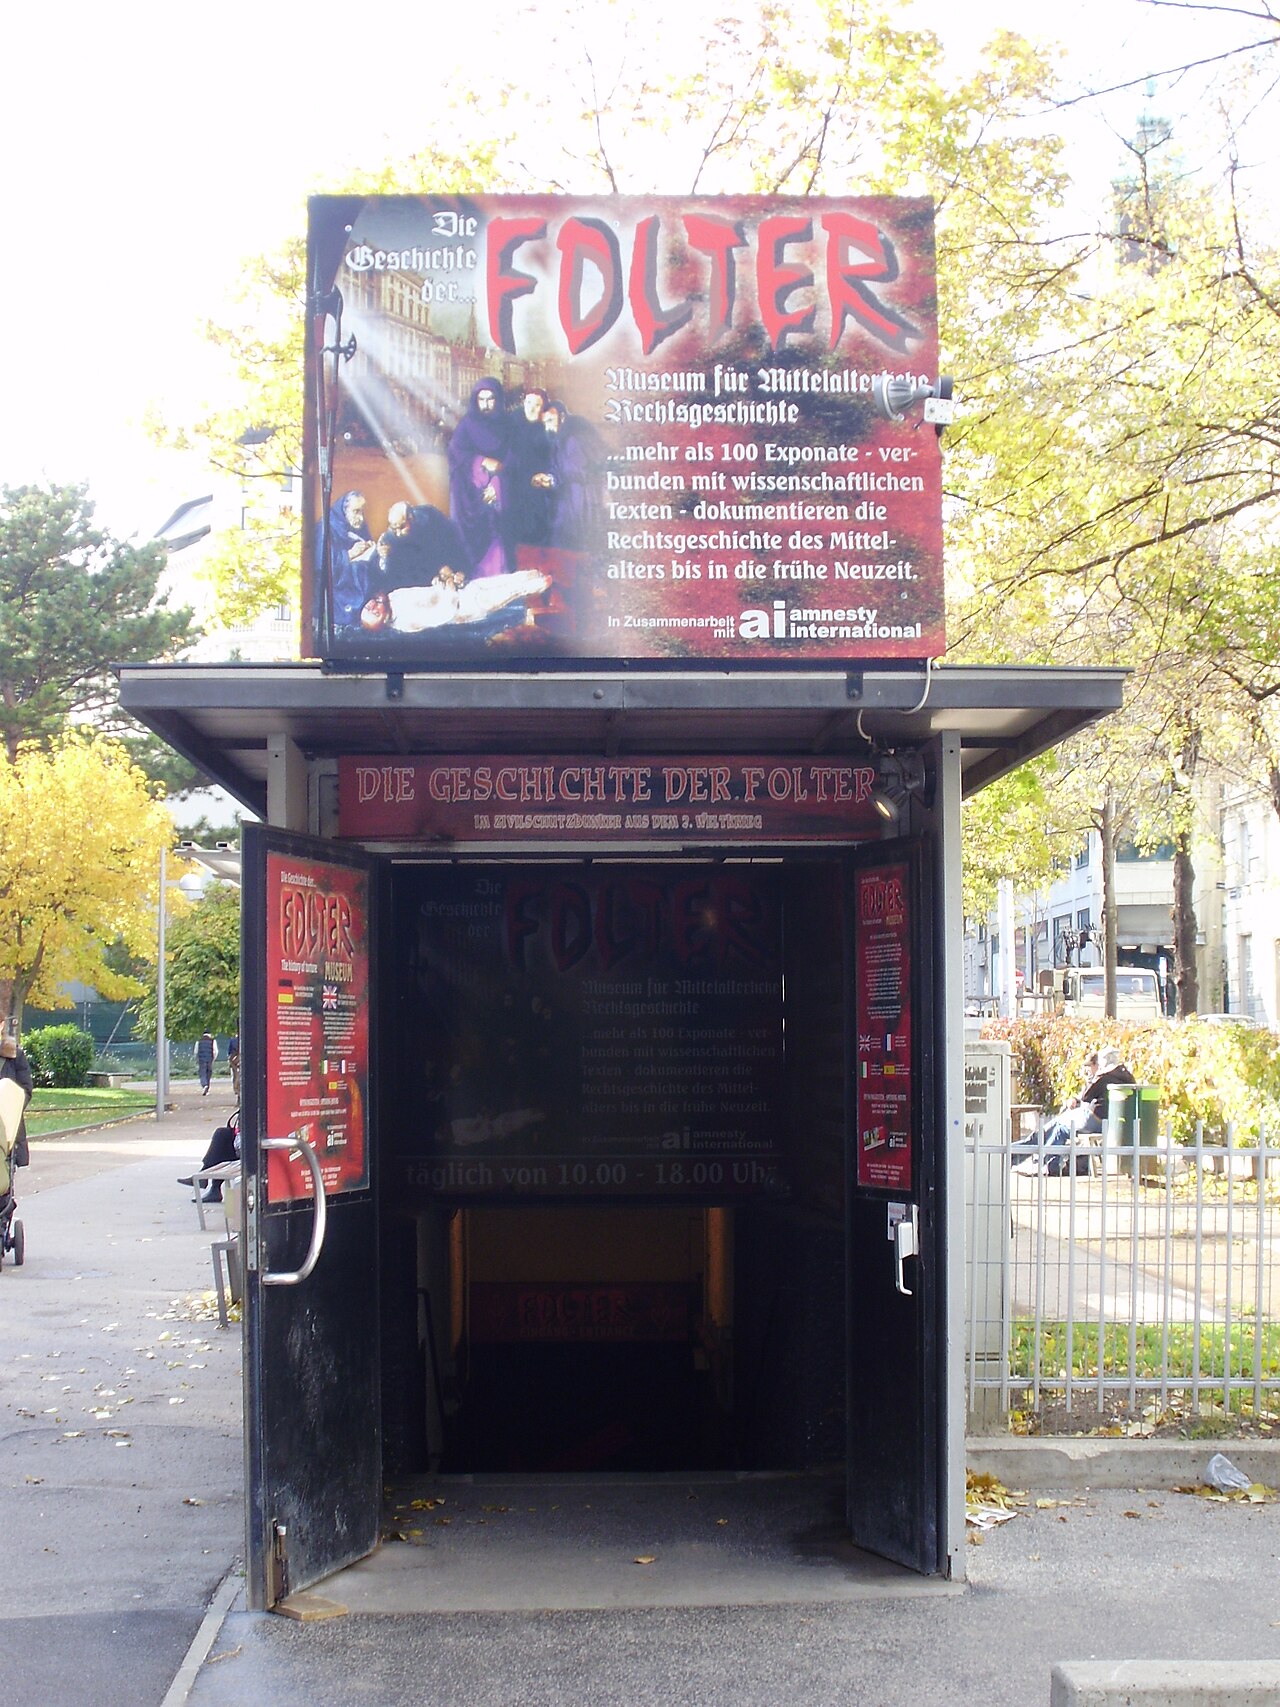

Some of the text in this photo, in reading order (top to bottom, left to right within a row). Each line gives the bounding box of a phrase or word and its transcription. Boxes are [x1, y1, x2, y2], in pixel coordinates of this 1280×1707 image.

[432, 211, 478, 237] Die
[345, 246, 477, 273] Geschichte
[486, 211, 926, 356] FOLTER
[604, 367, 706, 393] Museum
[714, 364, 749, 397] für
[604, 398, 799, 428] Rechtsgeschichte
[685, 442, 714, 462] als
[722, 443, 758, 462] 100
[765, 444, 859, 465] Exponate
[879, 446, 918, 462] ver-
[607, 472, 924, 491] bunden mit wissenschaftlichen
[608, 502, 673, 521] Texten
[693, 501, 849, 521] dokumentieren
[855, 502, 887, 521] die
[607, 531, 897, 554] Rechtsgeschichte des Mittel-
[607, 560, 919, 580] alters bis in die frühe Neuzeit.
[608, 615, 735, 628] In Zusammenarbeit
[739, 600, 786, 639] ai
[789, 608, 878, 623] amnesty
[714, 626, 735, 639] mit
[789, 622, 922, 639] international
[356, 766, 875, 803] DIE GESCHICHTE DER FOLTER
[625, 814, 649, 829] AUS
[652, 815, 679, 830] DEM
[281, 890, 354, 959] FOLTER
[324, 960, 353, 982] MUSEUM
[406, 1163, 493, 1188] täglich
[503, 1169, 549, 1184] von
[558, 1164, 626, 1184] 10.00
[655, 1163, 723, 1183] 18.00
